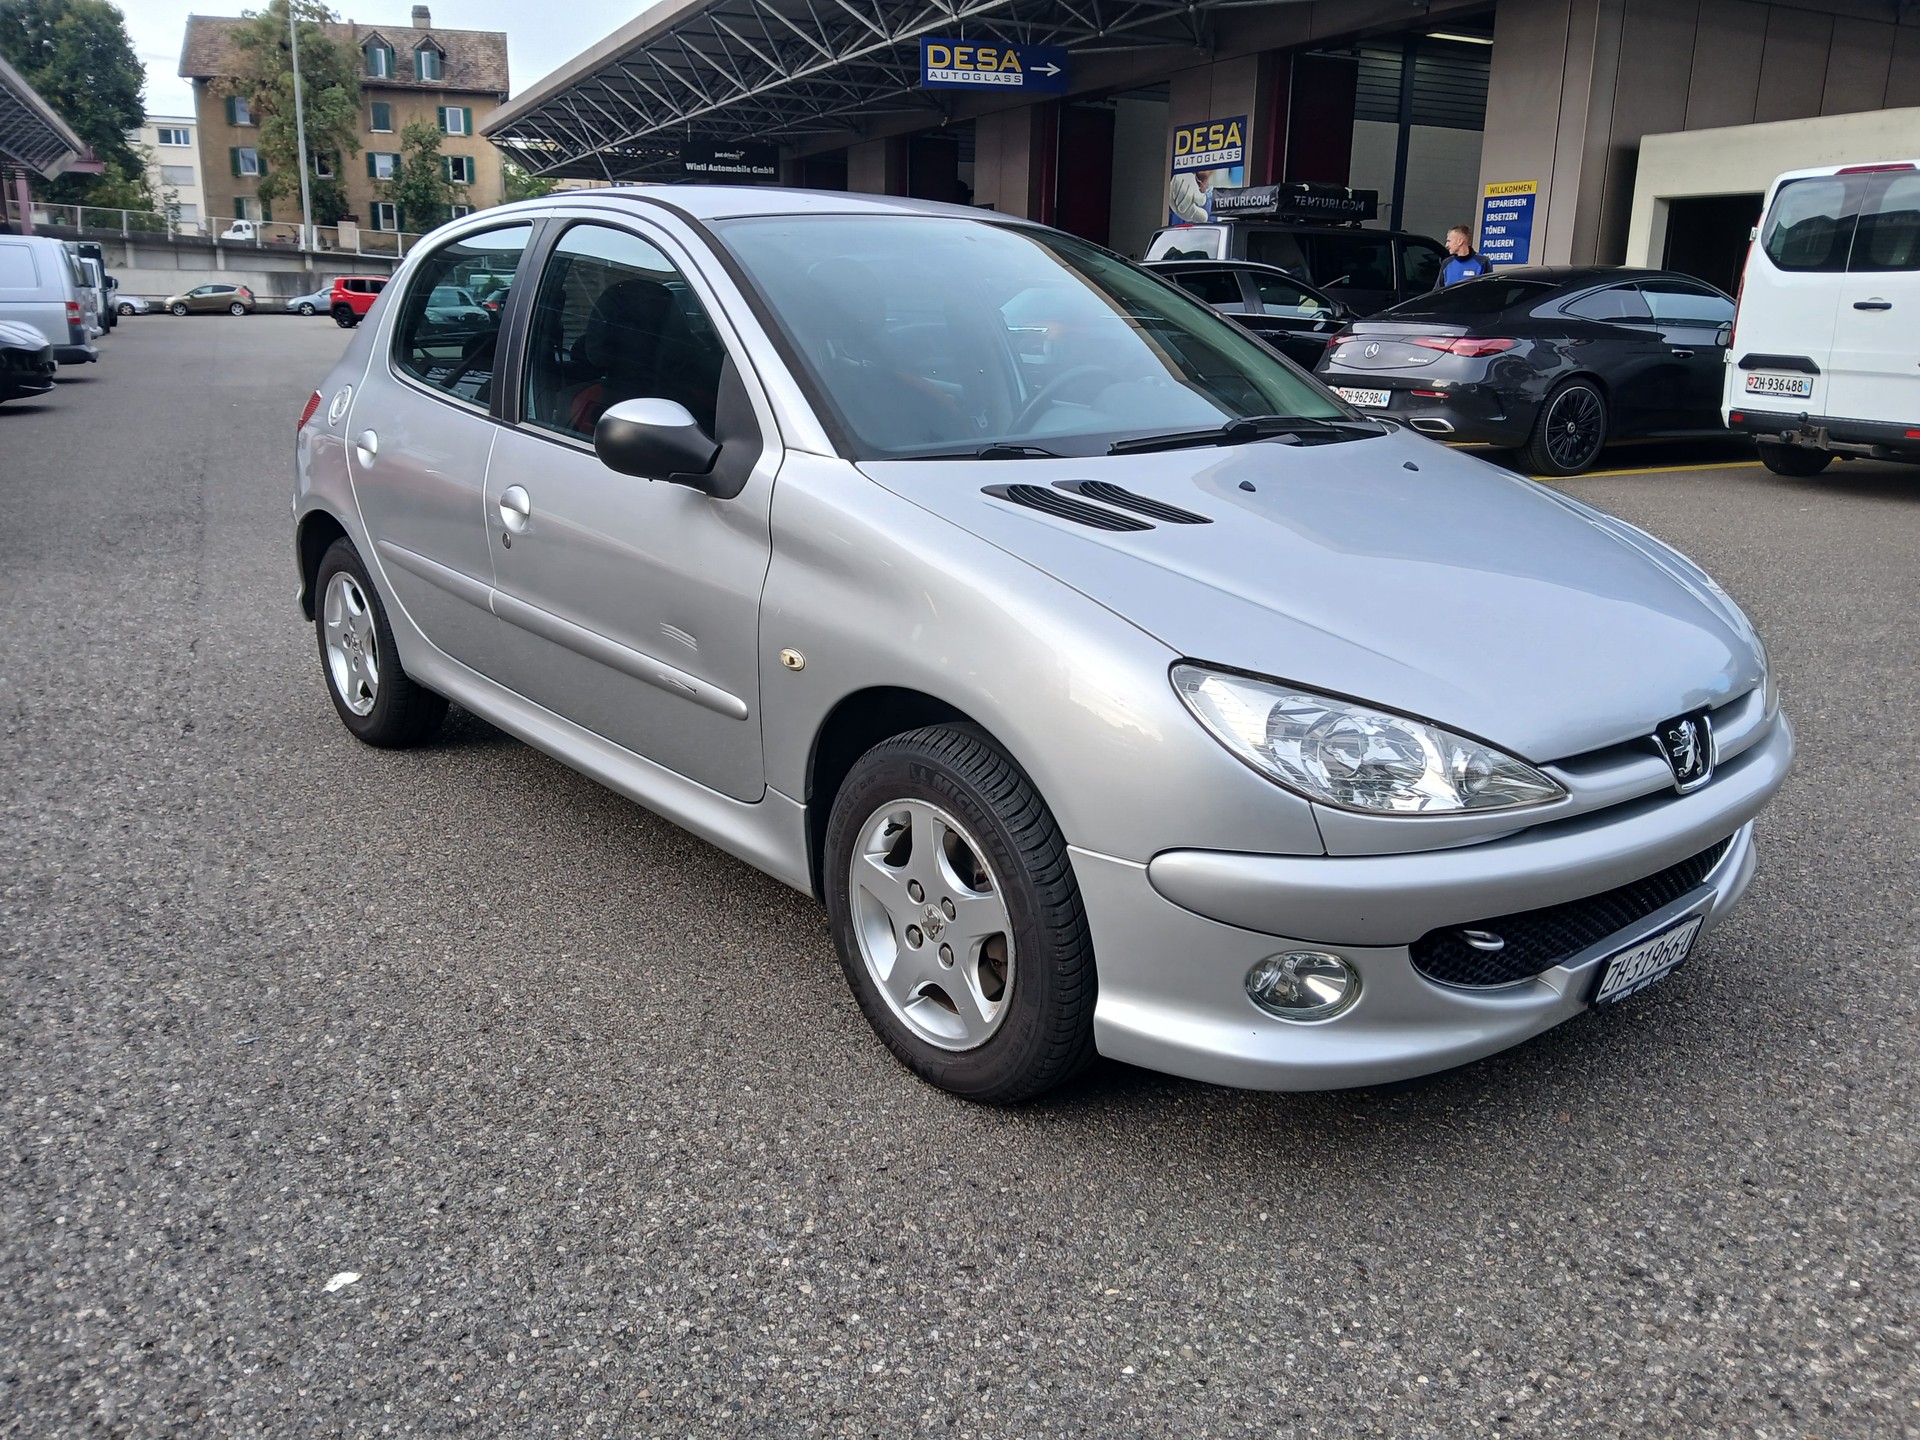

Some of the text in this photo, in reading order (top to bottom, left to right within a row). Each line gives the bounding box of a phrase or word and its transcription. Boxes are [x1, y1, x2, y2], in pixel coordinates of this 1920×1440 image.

[927, 44, 1022, 73] DESA
[929, 71, 1022, 83] AUTOGLASS
[1175, 121, 1242, 155] DESA
[1175, 150, 1241, 167] AUTOGLASS
[685, 162, 775, 174] Winti Automobile GmbH
[1489, 184, 1533, 194] WILLKOMMEN
[1215, 194, 1271, 208] TENTURI.COM
[1487, 198, 1527, 208] REPARIEREN
[1486, 212, 1518, 222] ERSETZEN
[1485, 225, 1506, 235] TÖNEN
[1483, 239, 1514, 248] POLIEREN
